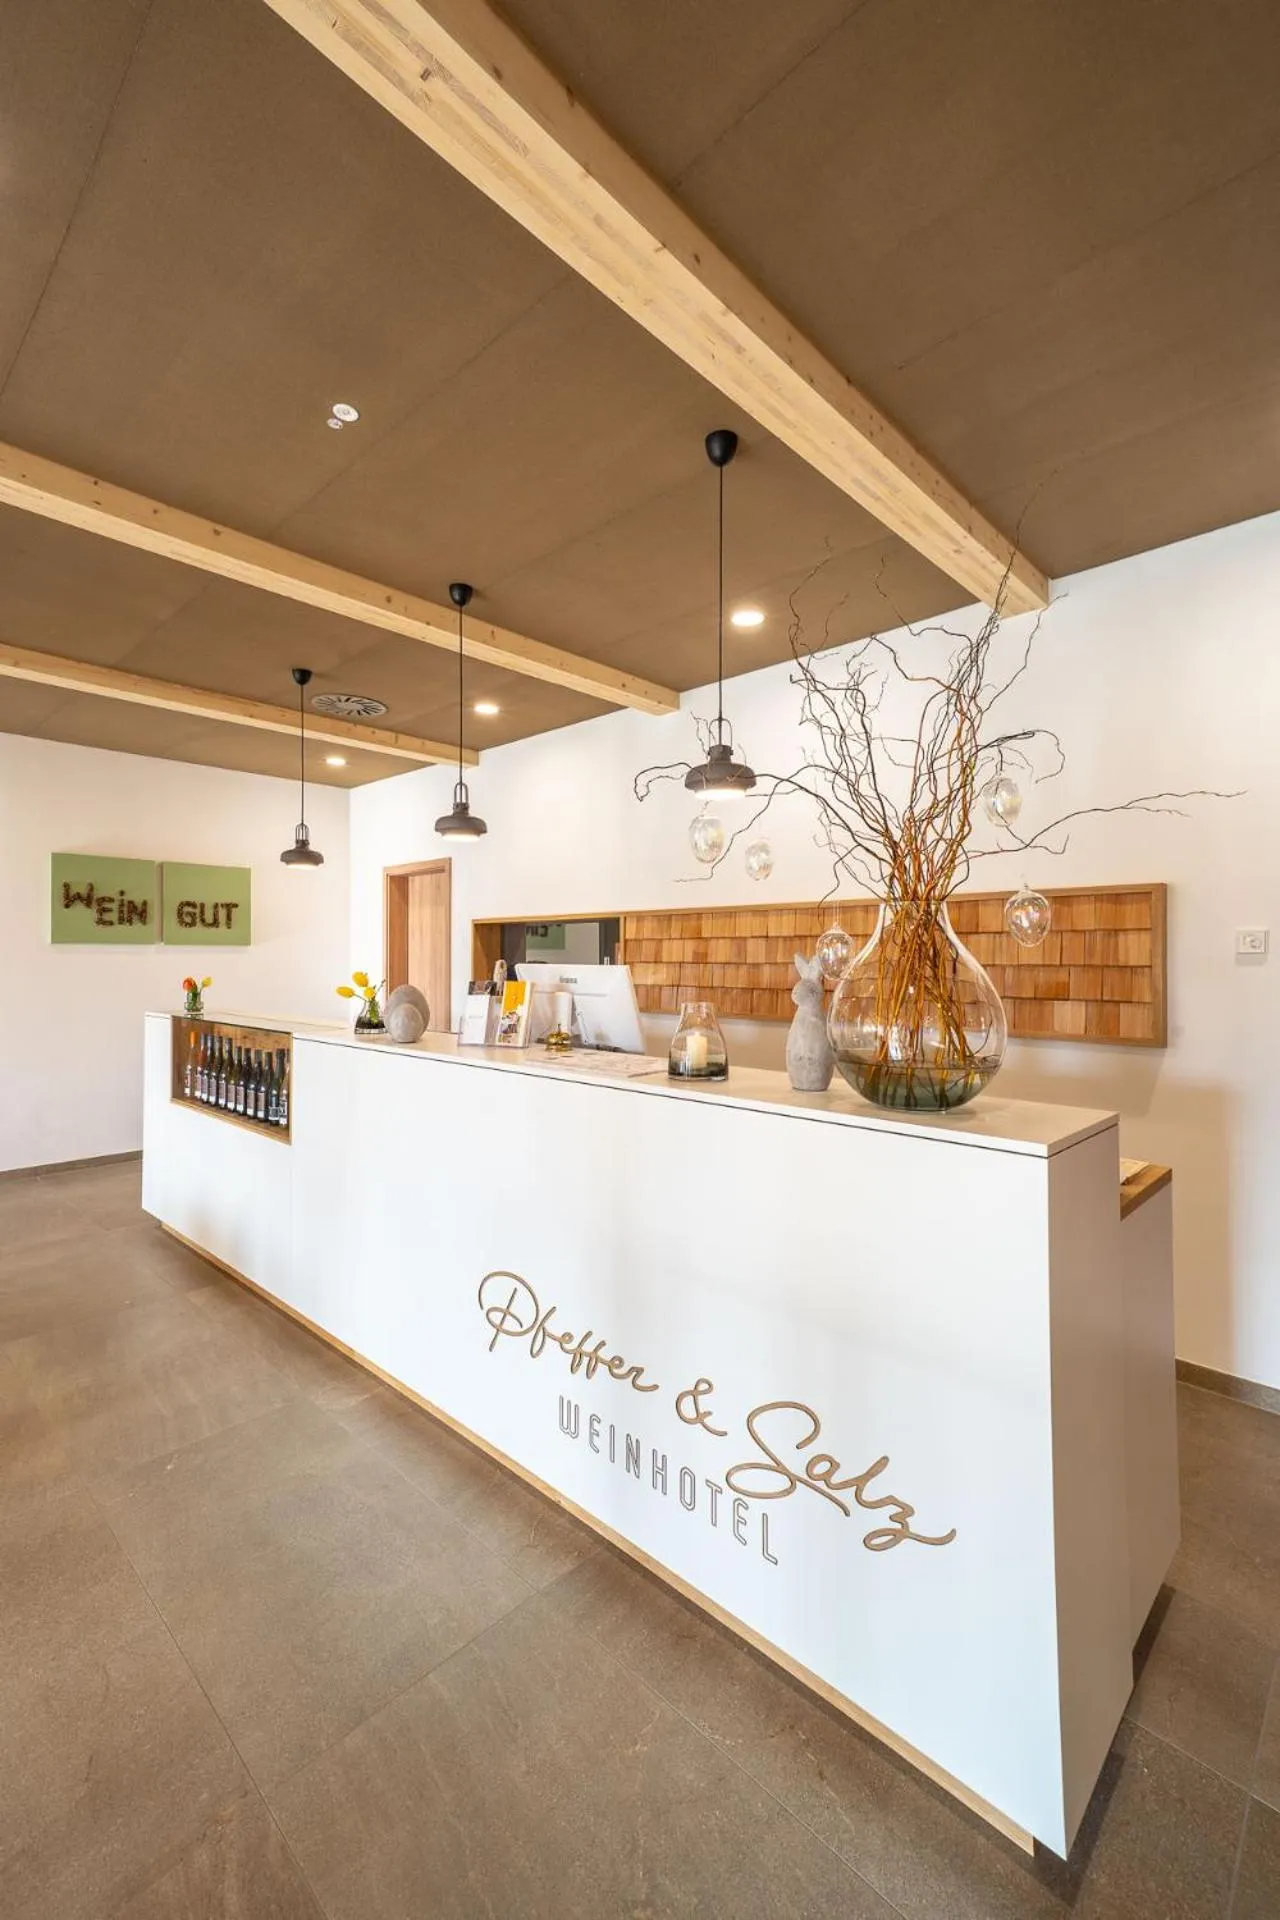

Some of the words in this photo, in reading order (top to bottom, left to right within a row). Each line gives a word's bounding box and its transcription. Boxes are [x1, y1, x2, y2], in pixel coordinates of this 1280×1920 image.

[176, 900, 239, 929] GUT
[478, 1271, 659, 1392] Pfeffer
[675, 1378, 727, 1437] &
[725, 1401, 956, 1551] Salz
[559, 1395, 778, 1565] WEINHOTEL
